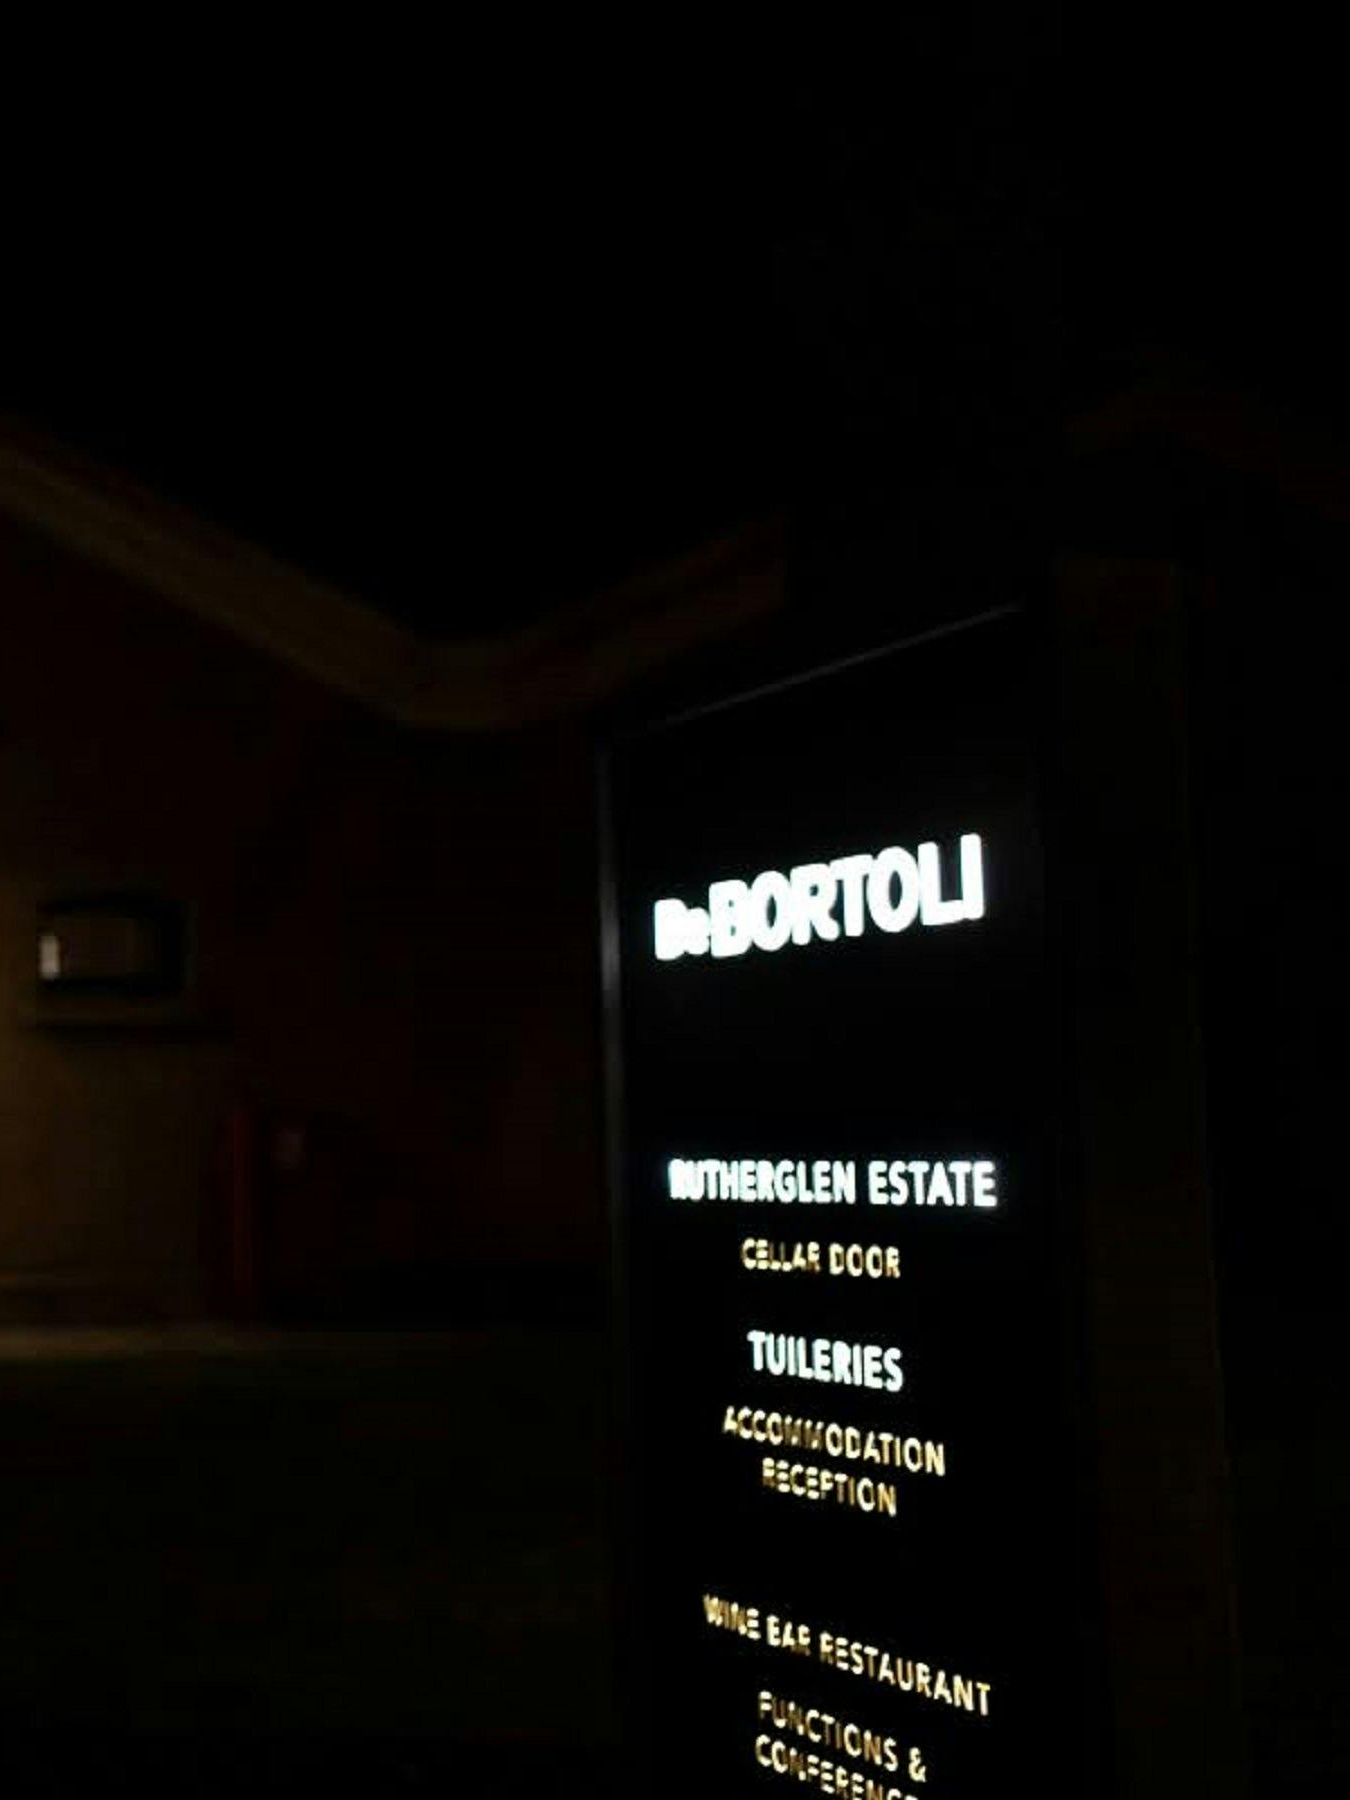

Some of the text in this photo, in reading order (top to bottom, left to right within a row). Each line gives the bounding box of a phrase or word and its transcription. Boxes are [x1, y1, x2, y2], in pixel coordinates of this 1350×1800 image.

[666, 1157, 999, 1208] RUTHERGLEN ESTATE
[741, 1237, 901, 1279] CELLAR DOOR
[746, 1329, 905, 1393] TUILERIES
[722, 1405, 946, 1477] ACCOMMODATION
[761, 1456, 898, 1518] RECEPTION
[702, 1593, 991, 1717] WINE BAR RESTAURANT
[755, 1733, 919, 1800] CONFEREN
[758, 1690, 927, 1783] FUNCTIONS &
